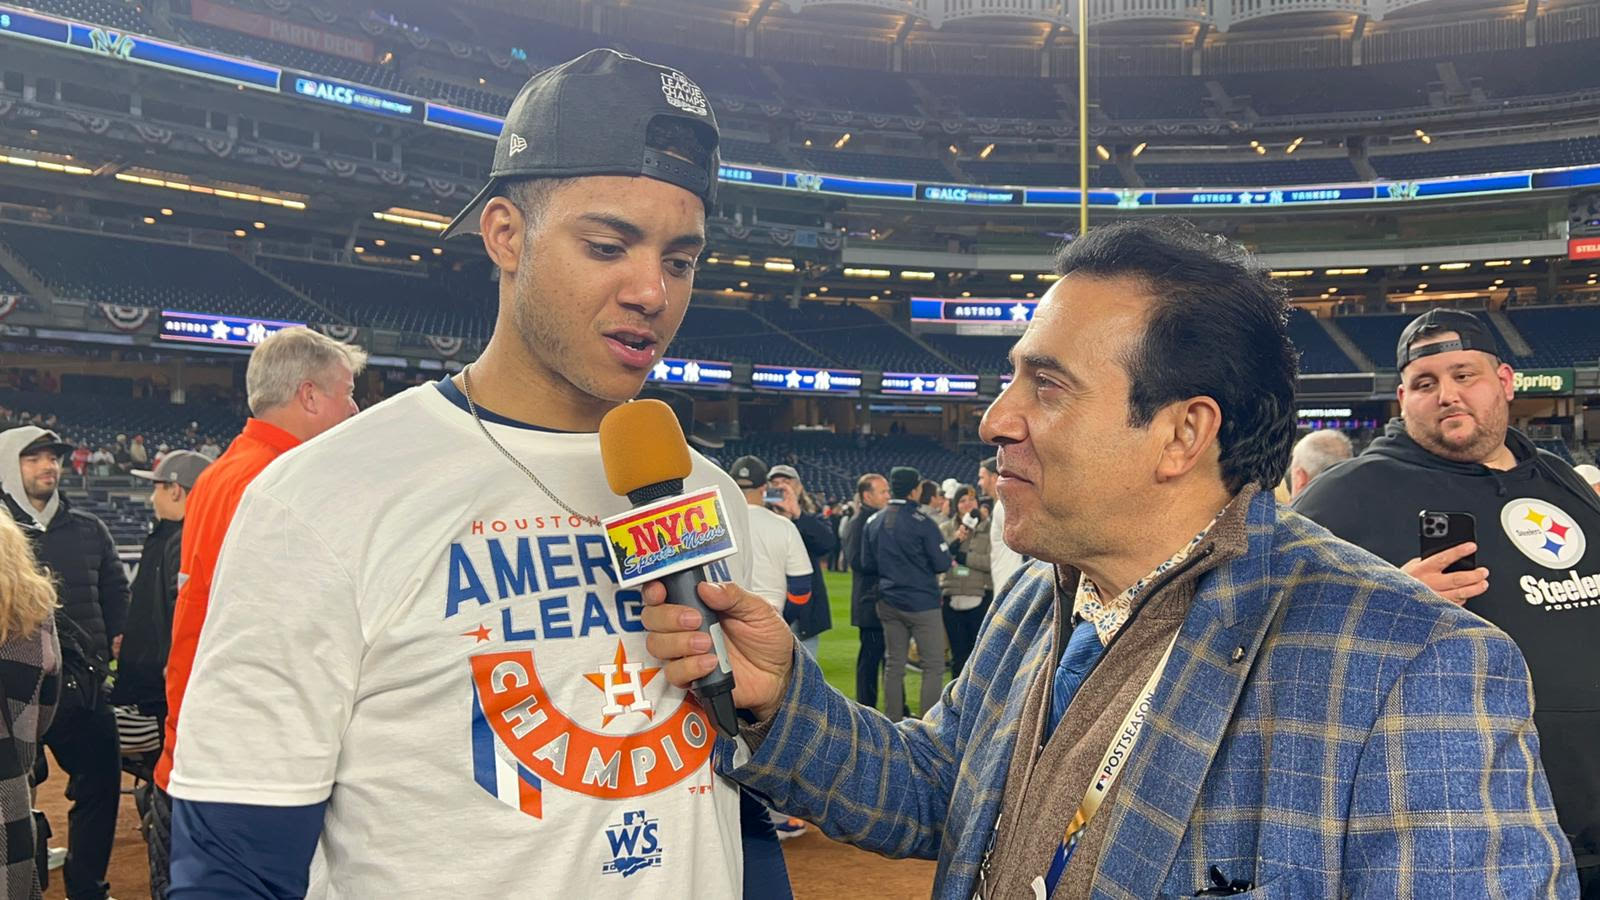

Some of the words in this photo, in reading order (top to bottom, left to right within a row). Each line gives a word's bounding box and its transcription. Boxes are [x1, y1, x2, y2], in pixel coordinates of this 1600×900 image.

[272, 20, 320, 49] PARTY
[316, 83, 355, 105] ALCS
[661, 75, 702, 99] LEAGUE
[662, 85, 706, 108] CHAMPS
[718, 167, 752, 180] NKEES
[940, 187, 968, 202] ALCS
[955, 306, 1002, 316] ASTROS
[165, 320, 208, 333] ASTROS
[1513, 372, 1564, 391] Spring
[628, 506, 709, 557] NYC
[624, 546, 675, 575] Sports
[681, 525, 726, 549] News
[501, 589, 646, 642] LEAG
[1545, 599, 1600, 611] FOOTBA
[490, 660, 708, 788] CHAMPIO
[1103, 690, 1154, 776] POSTSEASON
[605, 823, 658, 858] WS
